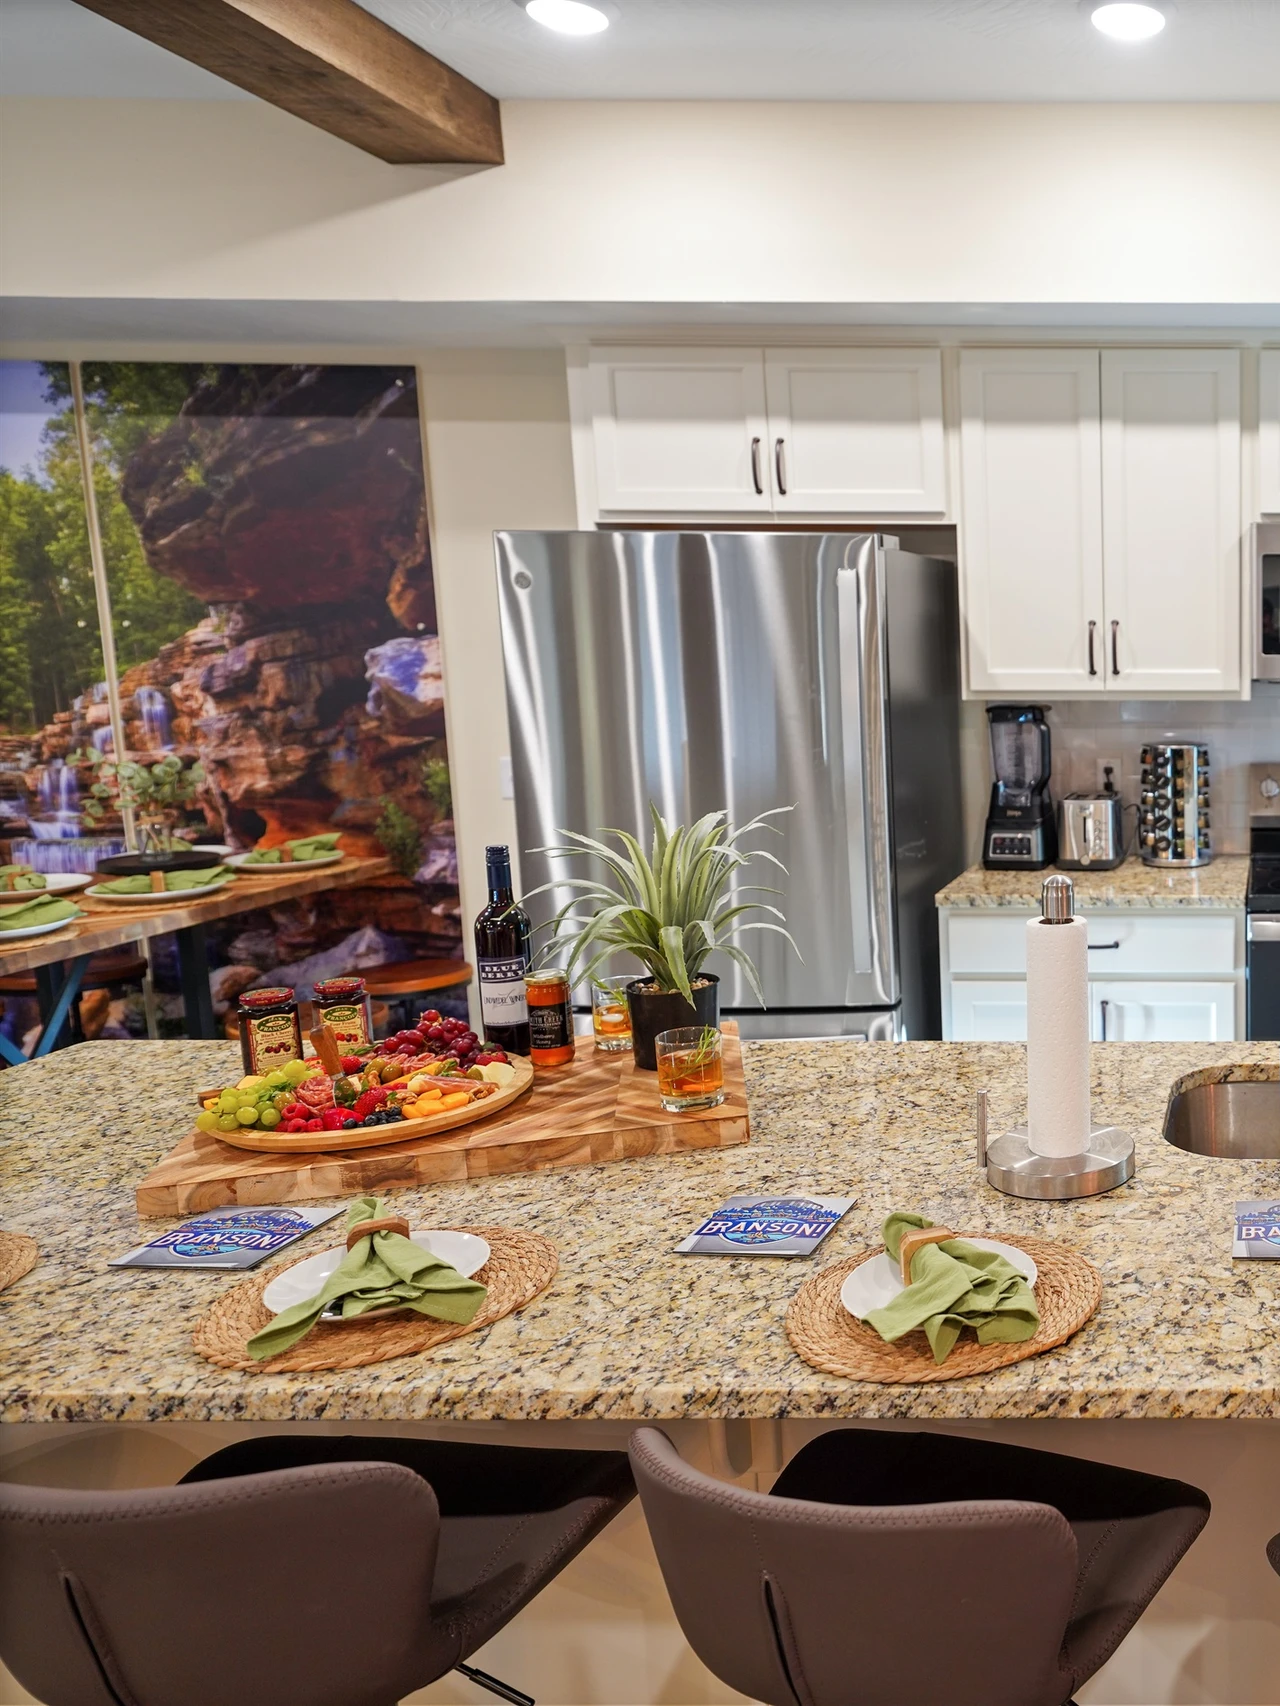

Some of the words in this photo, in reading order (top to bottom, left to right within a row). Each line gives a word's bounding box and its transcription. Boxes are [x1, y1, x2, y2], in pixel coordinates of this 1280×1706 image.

[484, 963, 520, 972] BLUE
[481, 970, 524, 979] BERRY
[701, 1221, 824, 1237] BRANSON!
[155, 1232, 288, 1249] BRANSON!
